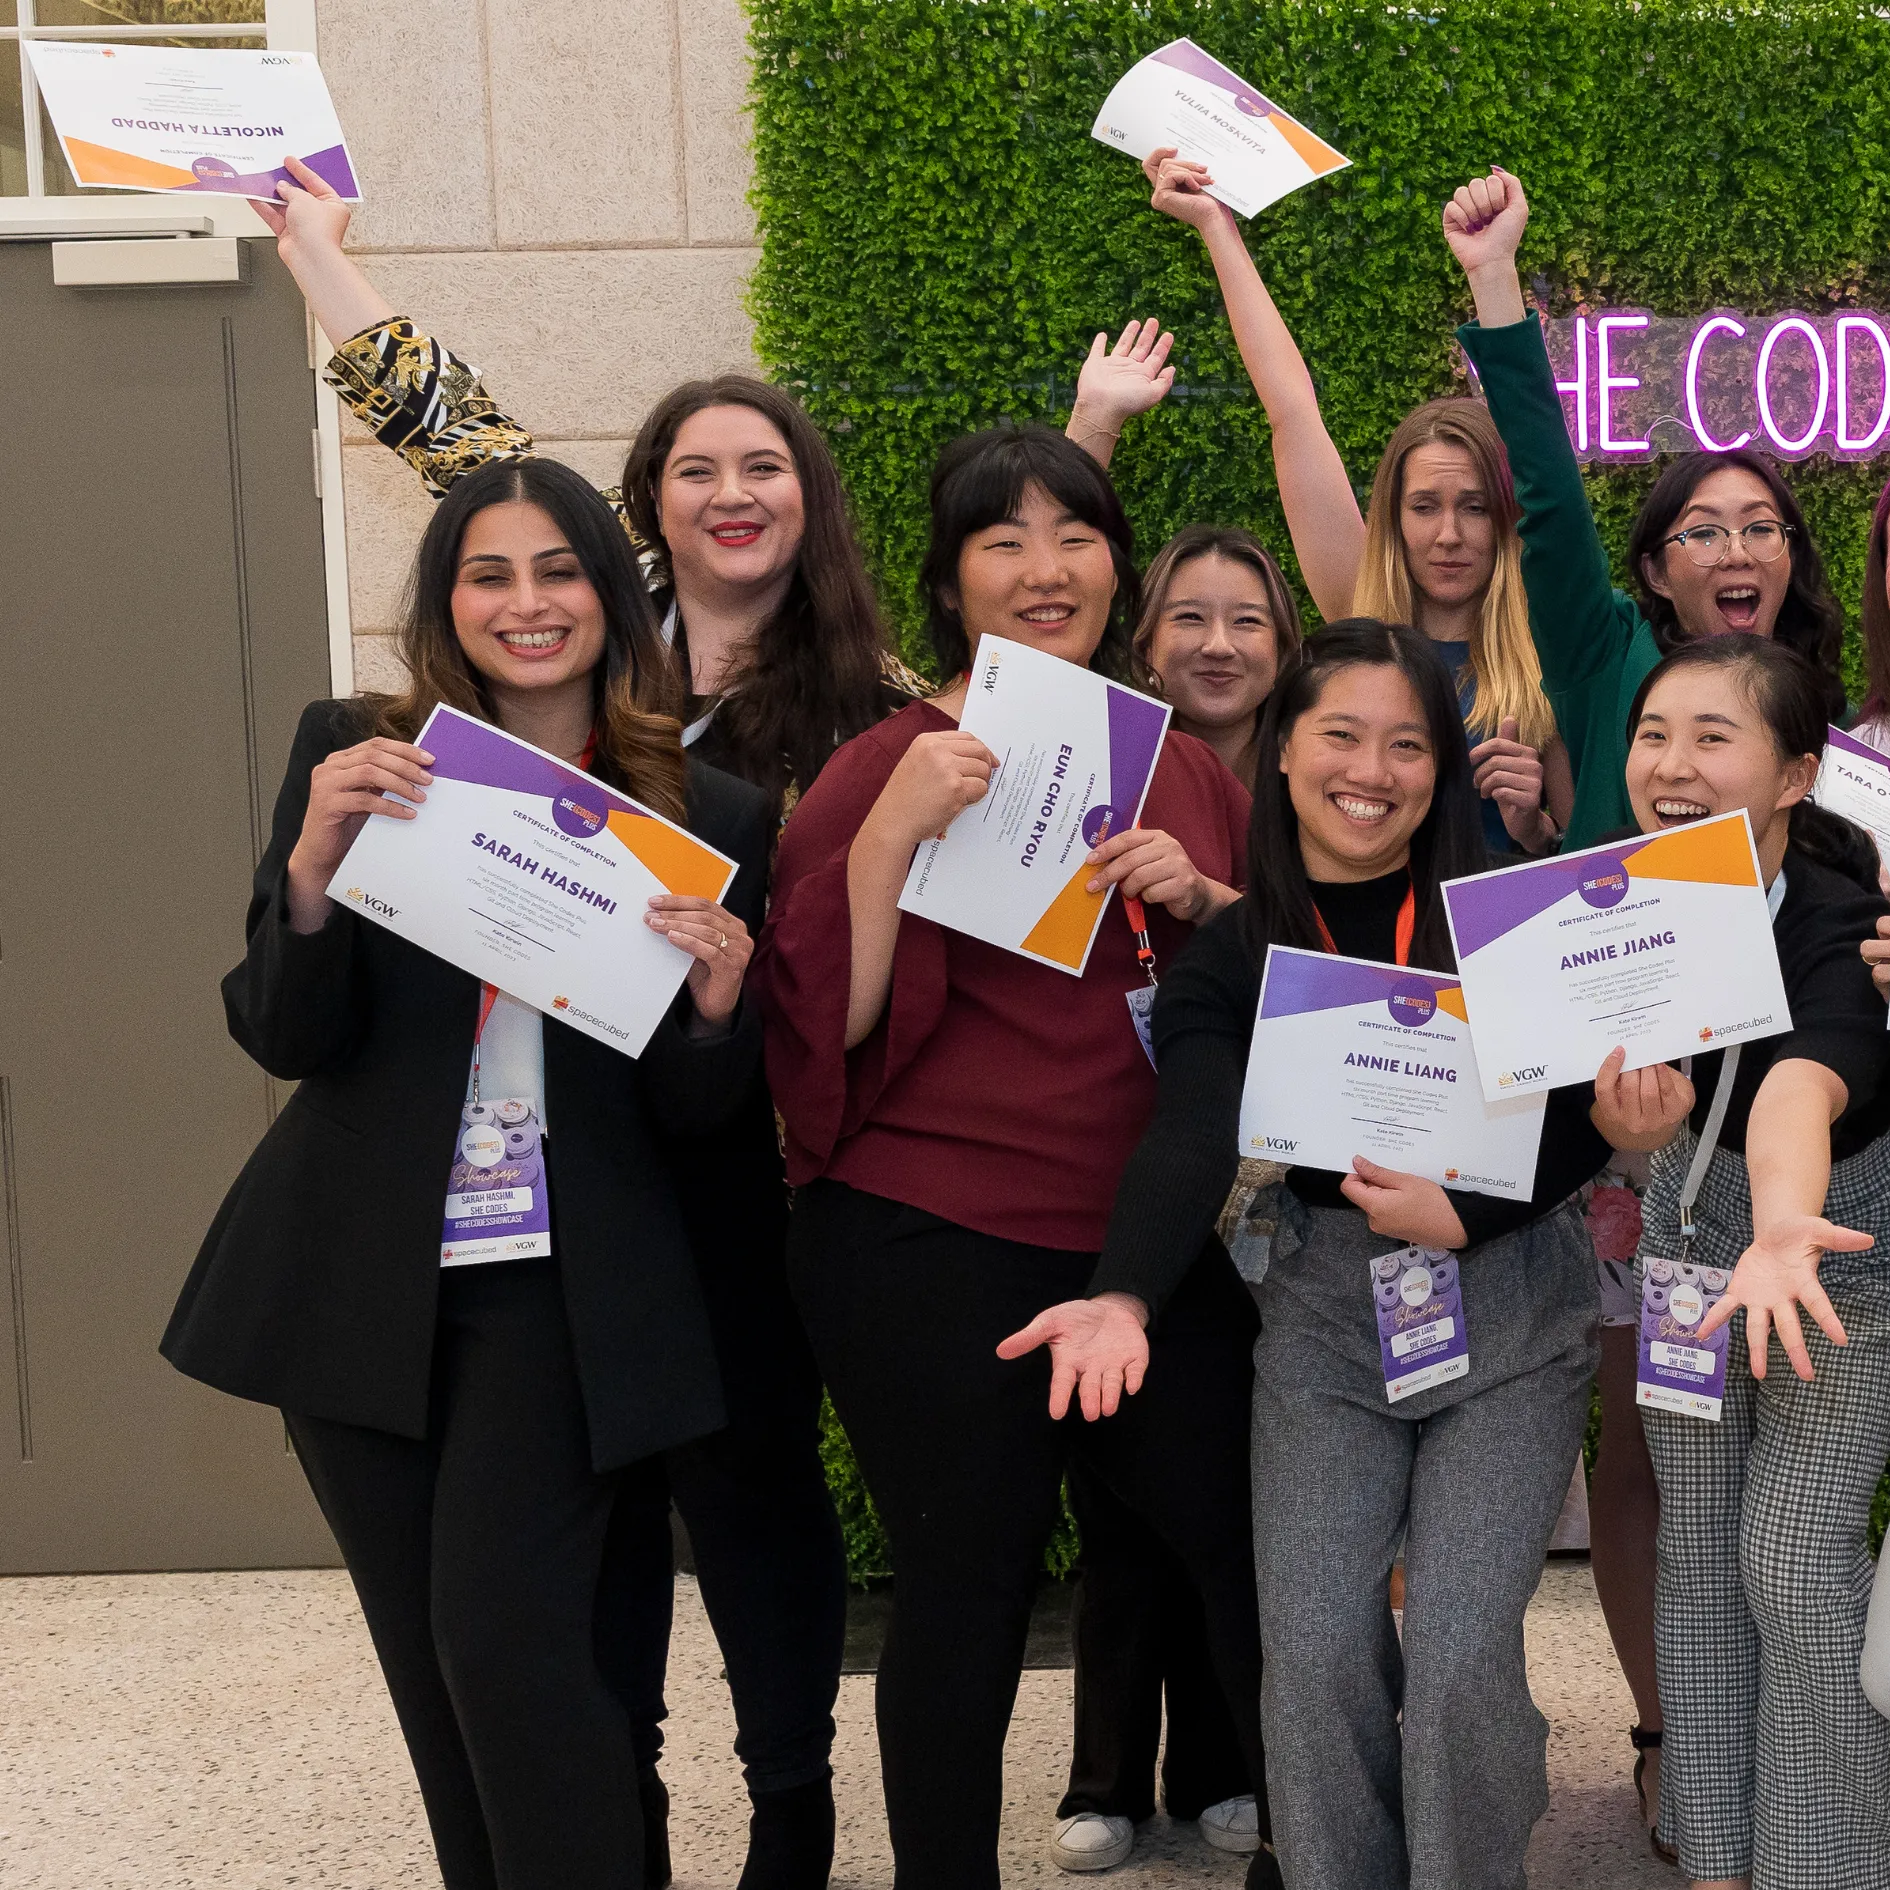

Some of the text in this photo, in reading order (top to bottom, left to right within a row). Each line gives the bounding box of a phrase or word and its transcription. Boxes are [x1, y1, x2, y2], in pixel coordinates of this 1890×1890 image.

[259, 56, 290, 64] VGW
[110, 118, 284, 137] NICOLETTA HADDAD
[1107, 126, 1128, 140] VGW
[1173, 89, 1211, 116] YULIIA
[1207, 114, 1269, 154] MOSKVITA
[982, 663, 999, 692] VGW
[1836, 765, 1872, 790] TARA
[1019, 743, 1073, 869] EUN CHO RYOU
[1059, 772, 1096, 864] CERTIFICATE OF COMPLETION
[512, 808, 617, 869] CERTIFICATE OF COMPLETION
[470, 830, 617, 916] SARAH HASHMI
[915, 838, 940, 896] spacecubed
[360, 893, 398, 919] VGW
[1558, 897, 1660, 927] CERTIFICATE OF COMPLETION
[1558, 930, 1676, 970] ANNIE JIANG
[566, 1002, 629, 1042] spacecubed
[1358, 1020, 1401, 1032] CERTIFICATE
[1412, 1029, 1456, 1041] COMPLETION
[1713, 1013, 1773, 1037] spacecubed
[1344, 1051, 1457, 1082] ANNIE LIANG
[1513, 1065, 1546, 1082] VGW
[1265, 1137, 1297, 1152] VGW
[453, 1165, 522, 1187] Showcase
[1458, 1171, 1516, 1189] spacecubed
[462, 1194, 484, 1204] SARAH
[471, 1204, 508, 1215] SHE CODES
[1421, 1335, 1436, 1346] CODES
[1680, 1360, 1696, 1370] CODES
